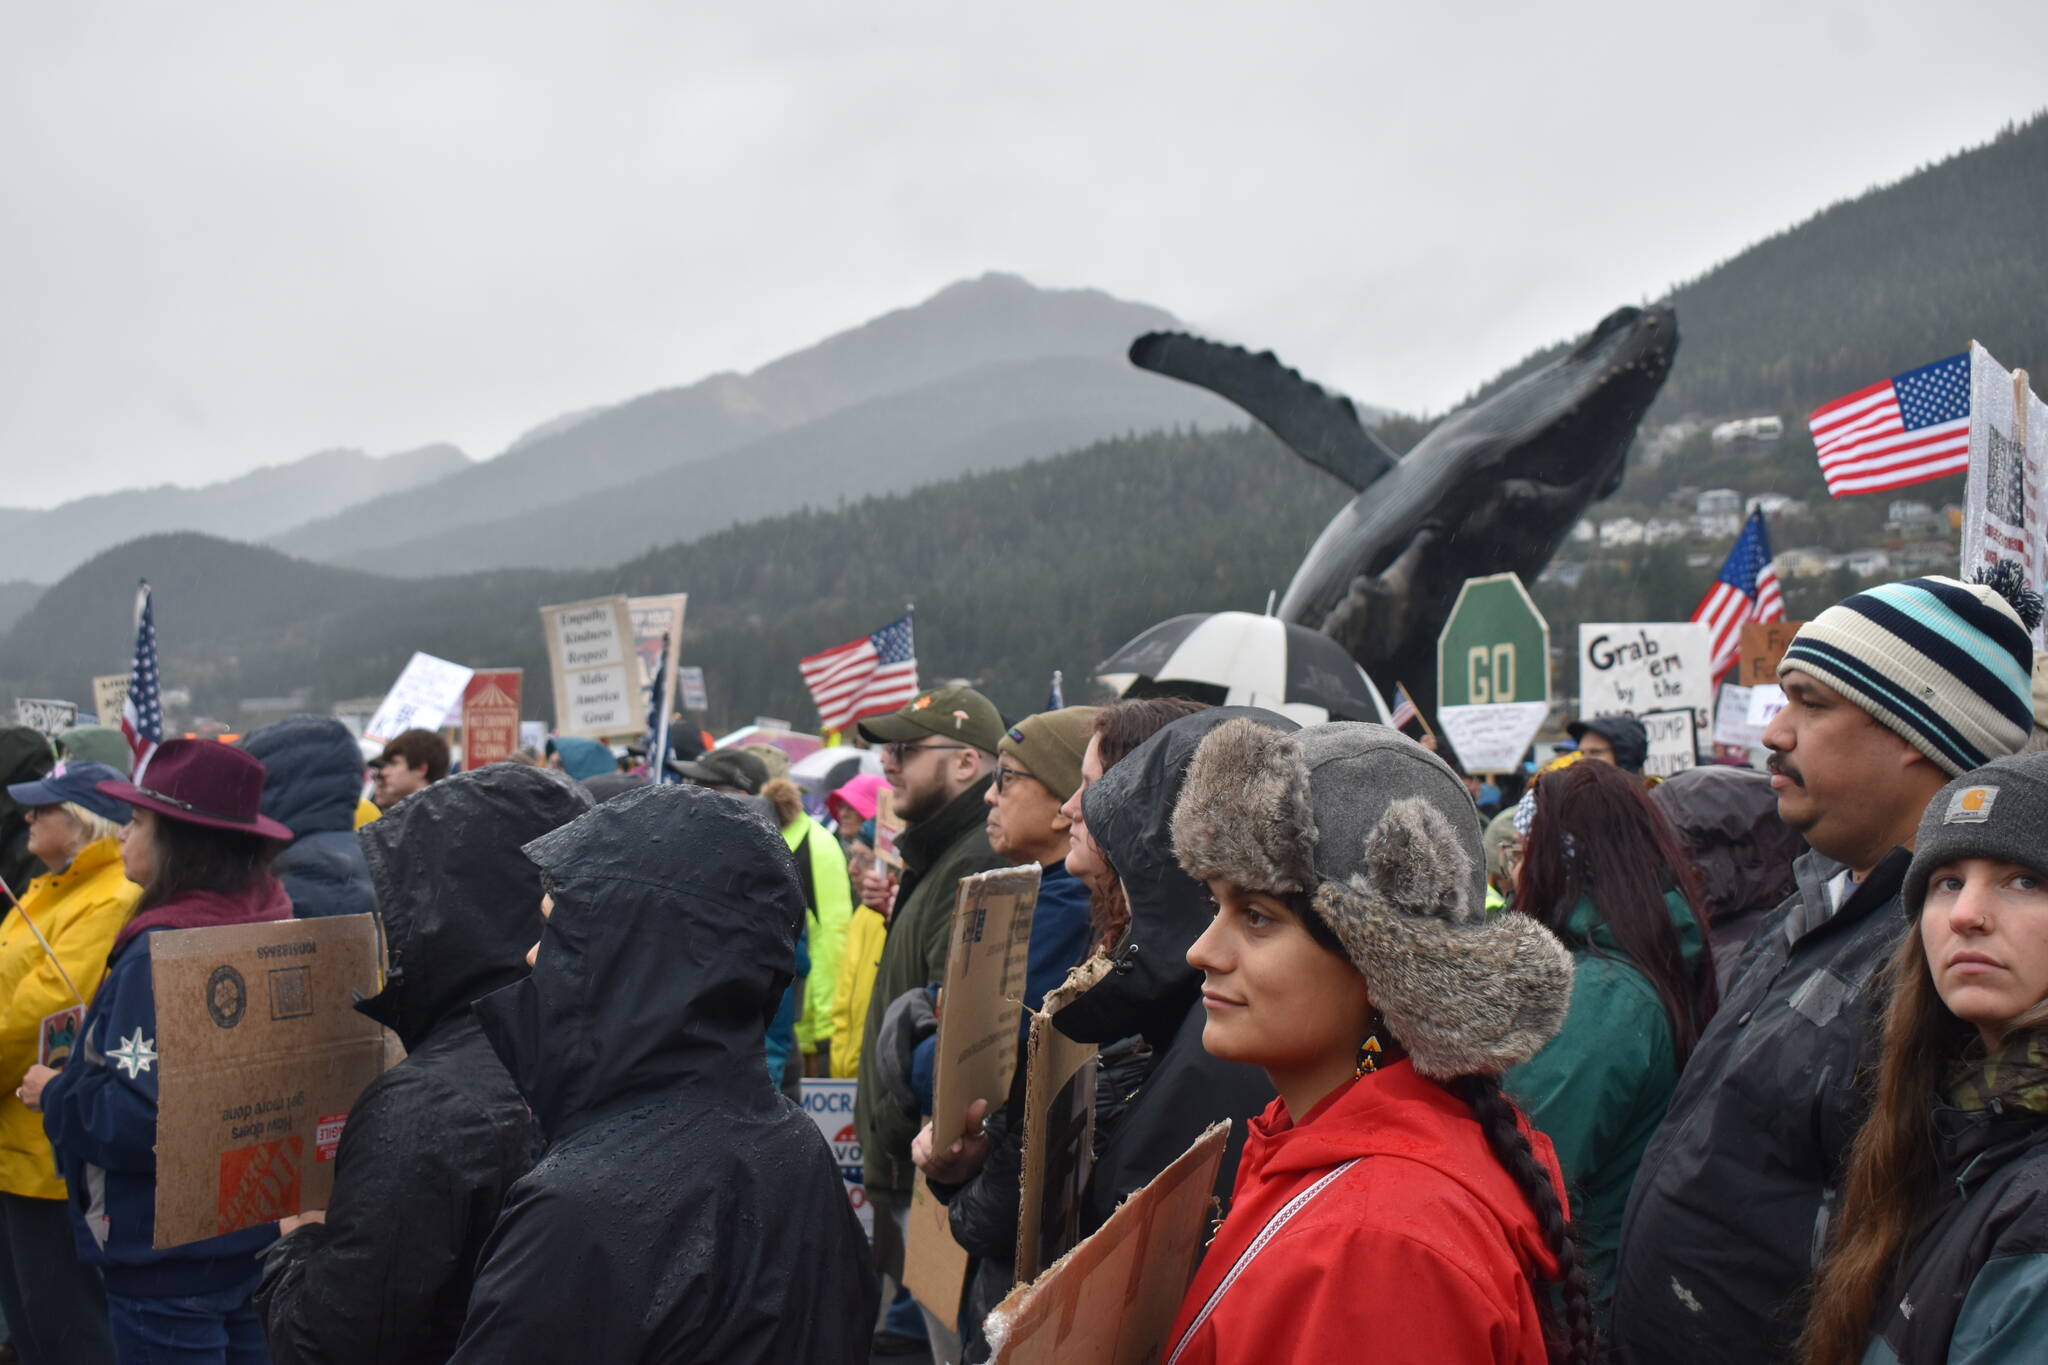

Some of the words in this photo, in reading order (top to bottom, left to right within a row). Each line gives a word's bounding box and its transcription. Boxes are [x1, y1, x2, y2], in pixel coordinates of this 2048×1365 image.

[560, 609, 608, 626] Empathy
[565, 629, 612, 645] Kindness
[568, 649, 609, 665] Respect
[1588, 629, 1660, 670] Grab
[579, 673, 609, 686] Make
[1468, 643, 1515, 704] GO
[576, 691, 620, 706] America
[1614, 681, 1635, 703] by
[1653, 678, 1682, 698] the
[583, 711, 614, 724] Great
[800, 1092, 854, 1112] MOCR
[319, 1126, 345, 1141] AGILE
